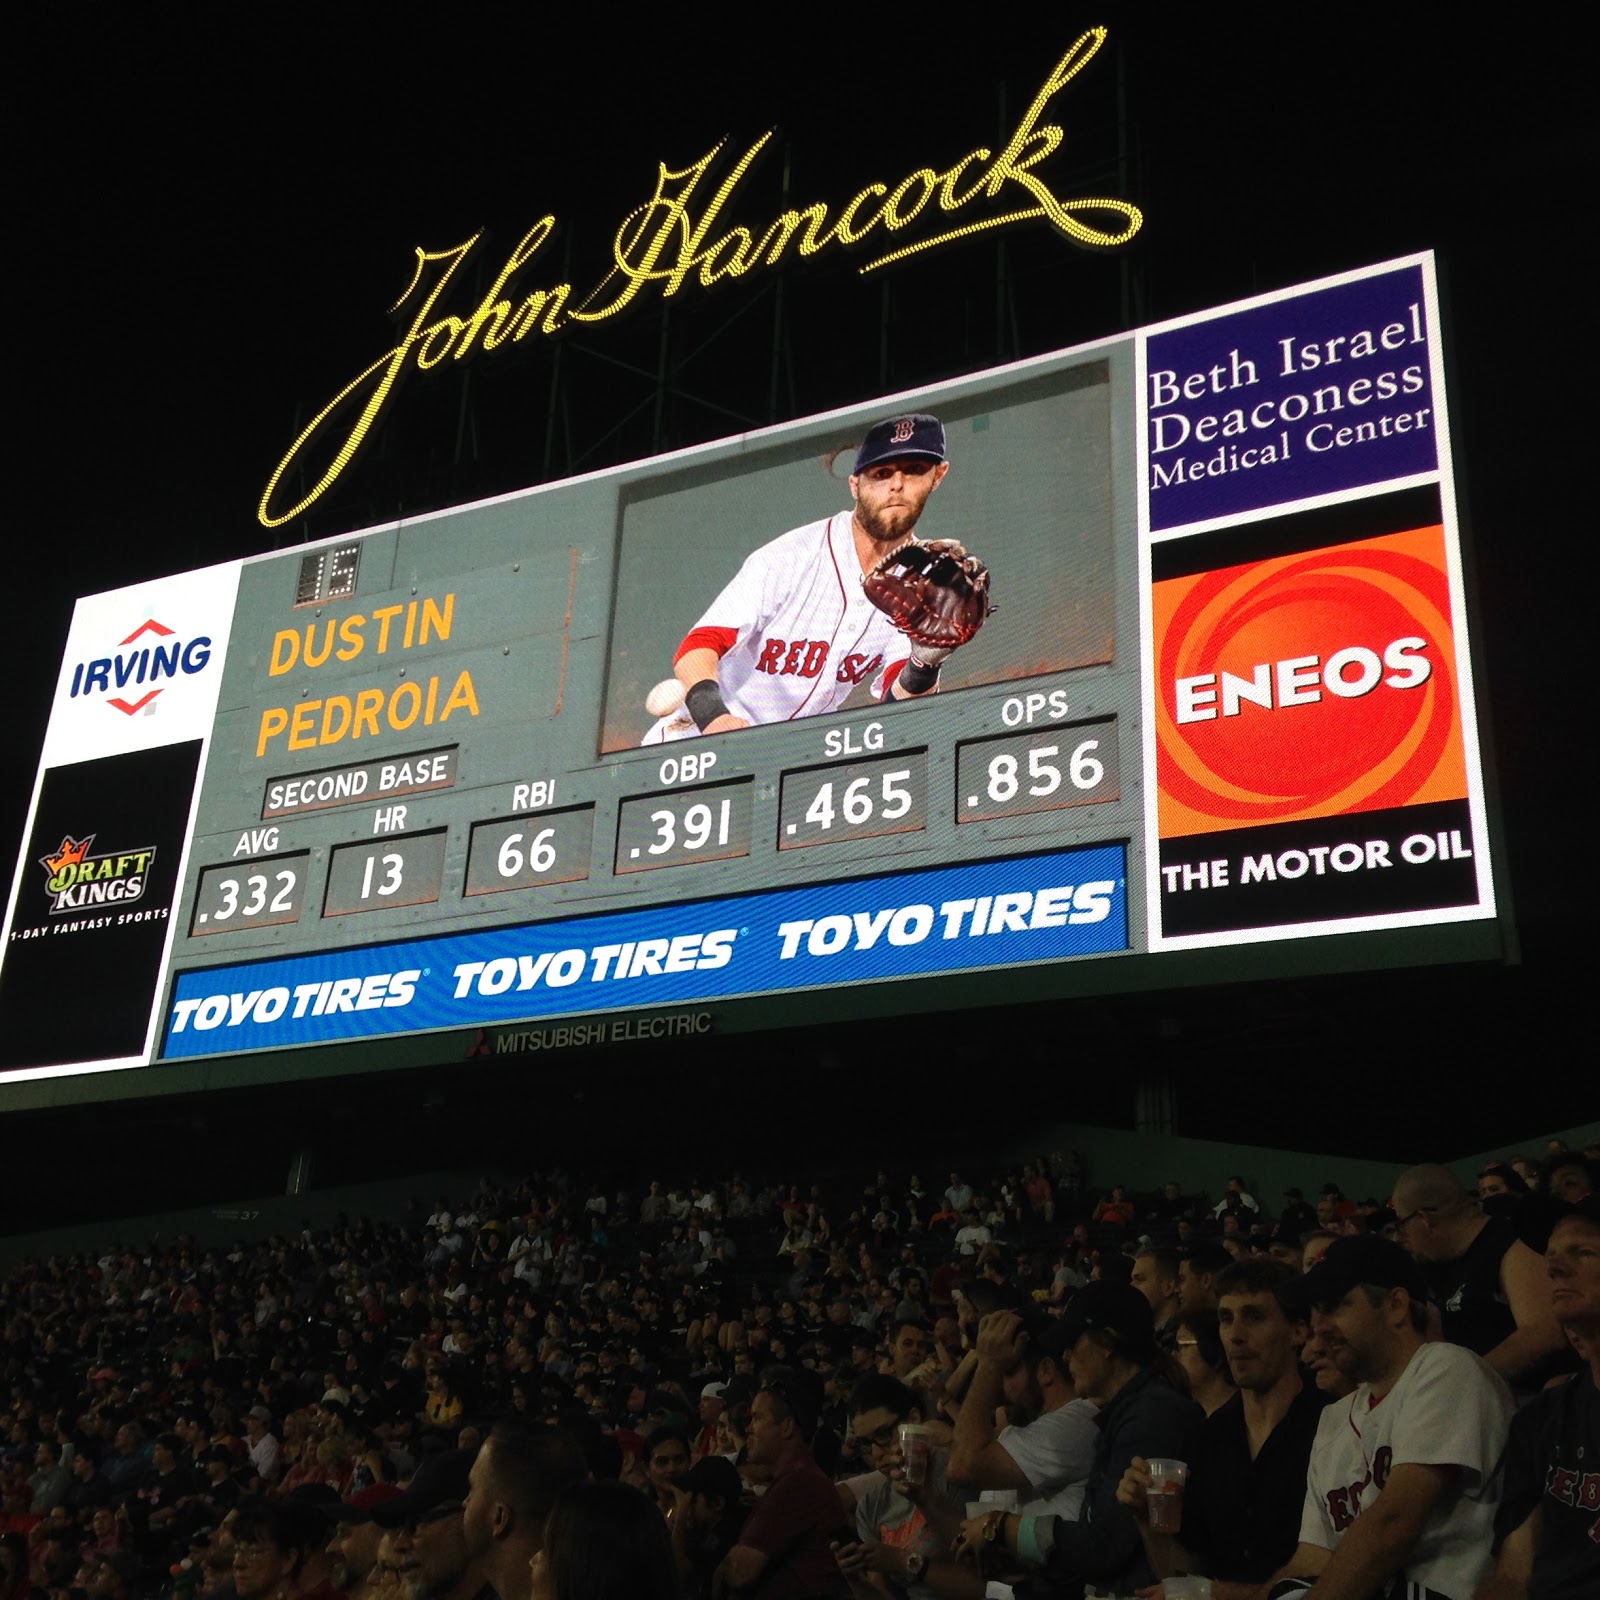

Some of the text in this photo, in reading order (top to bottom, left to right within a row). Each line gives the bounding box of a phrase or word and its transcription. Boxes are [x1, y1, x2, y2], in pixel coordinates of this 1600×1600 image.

[257, 25, 1144, 528] John Hancock
[1149, 302, 1426, 410] Beth Israel
[1150, 365, 1426, 455] Deaconess
[1150, 407, 1431, 490] Medical Center
[314, 547, 358, 600] 15
[268, 593, 456, 678] DUSTIN
[755, 638, 831, 679] RED
[70, 636, 212, 698] IRVING
[1175, 636, 1433, 726] ENEOS
[255, 670, 480, 758] PEDROIA
[1001, 690, 1069, 727] OPS
[824, 722, 885, 757] SLG
[269, 755, 449, 811] SECOND BASE
[511, 779, 556, 811] RBI
[659, 751, 718, 786] OBP
[966, 739, 1105, 809] .856
[373, 805, 408, 834] HR
[629, 799, 731, 859] .391
[784, 769, 913, 836] .465
[233, 827, 280, 857] AVG
[497, 828, 558, 878] 66
[1161, 829, 1474, 894] THE MOTOR OIL
[49, 852, 152, 893] DRAFT
[56, 876, 142, 910] KINGS
[199, 870, 297, 923] .332
[361, 853, 404, 899] 13
[11, 907, 169, 941] 1-DAY FANTASY SPORTS
[496, 1012, 712, 1055] MITSUBISHI ELECTRIC
[240, 1210, 259, 1221] 37
